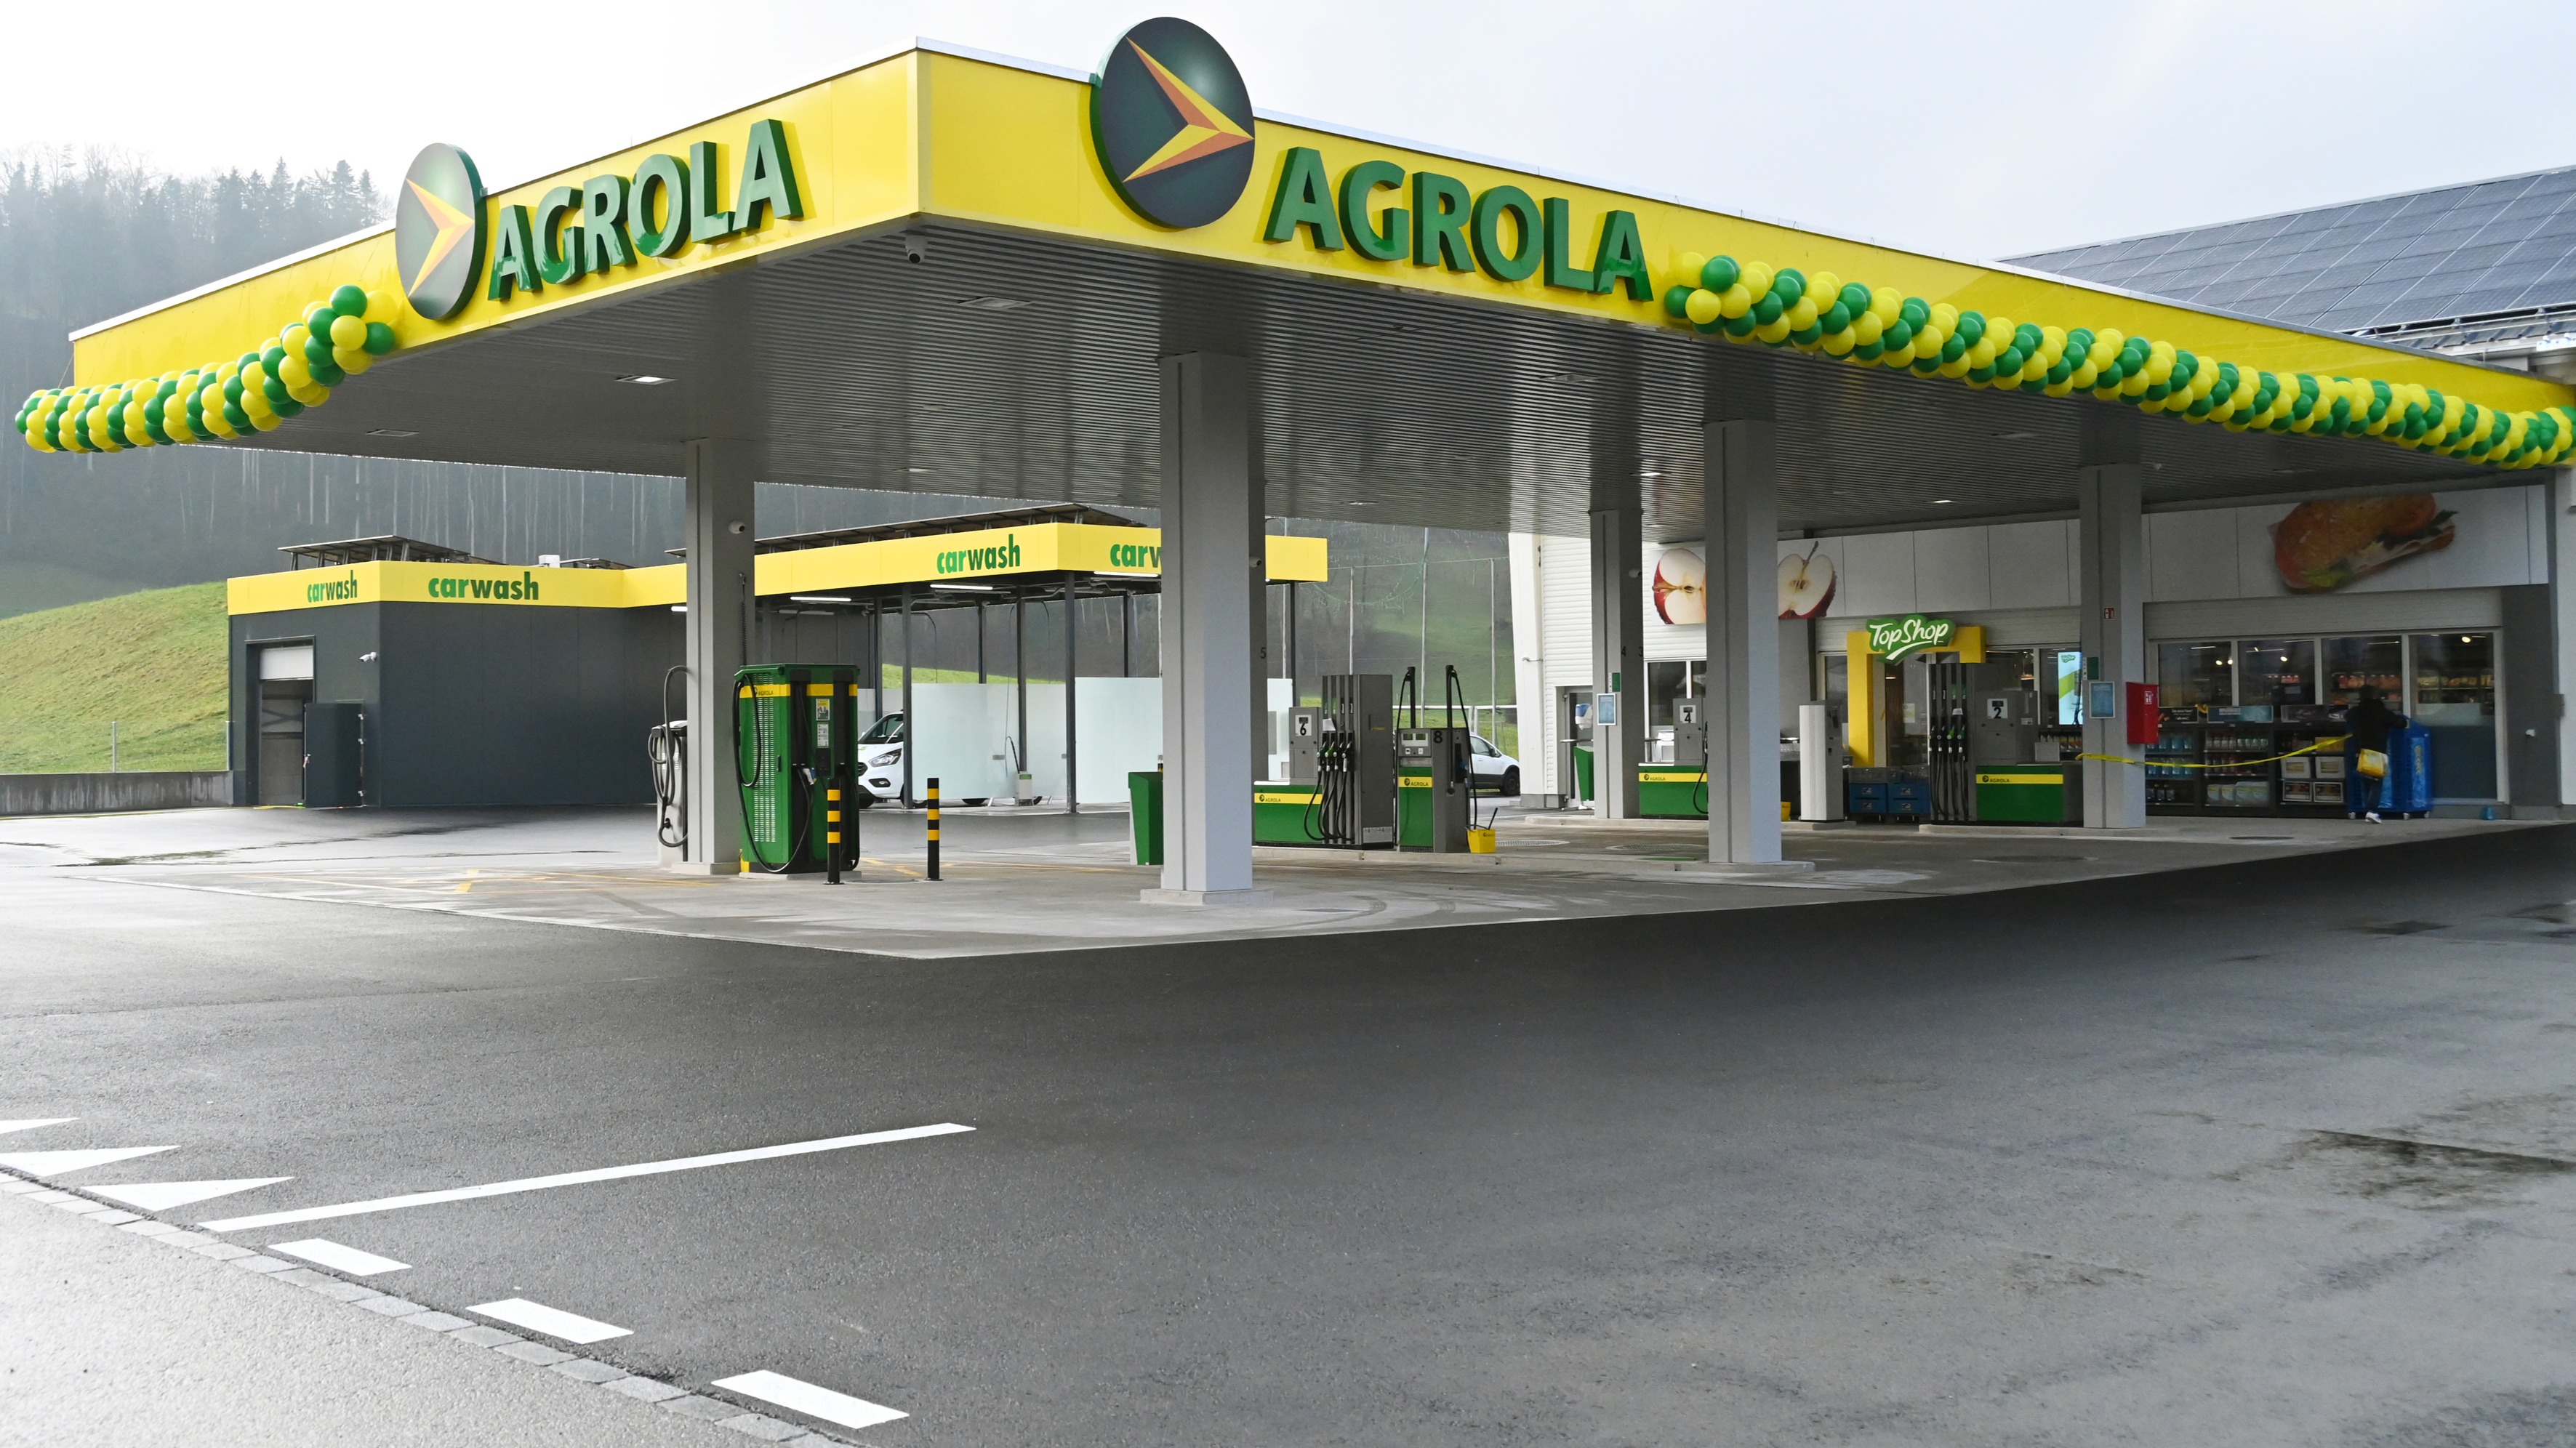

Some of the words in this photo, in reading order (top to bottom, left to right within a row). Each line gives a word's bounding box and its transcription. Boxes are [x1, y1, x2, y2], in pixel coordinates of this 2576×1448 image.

[488, 118, 803, 301] AGROLA
[1263, 146, 1654, 302] AGROLA
[936, 534, 1021, 574] carwash
[1110, 544, 1162, 568] carw
[307, 570, 358, 603] carwash
[428, 571, 539, 600] carwash
[1869, 619, 1949, 651] TopShop
[1259, 646, 1267, 659] 5
[1684, 712, 1692, 724] 4
[1993, 707, 2002, 719] 2
[1299, 722, 1307, 736] 6
[1433, 730, 1443, 744] 8
